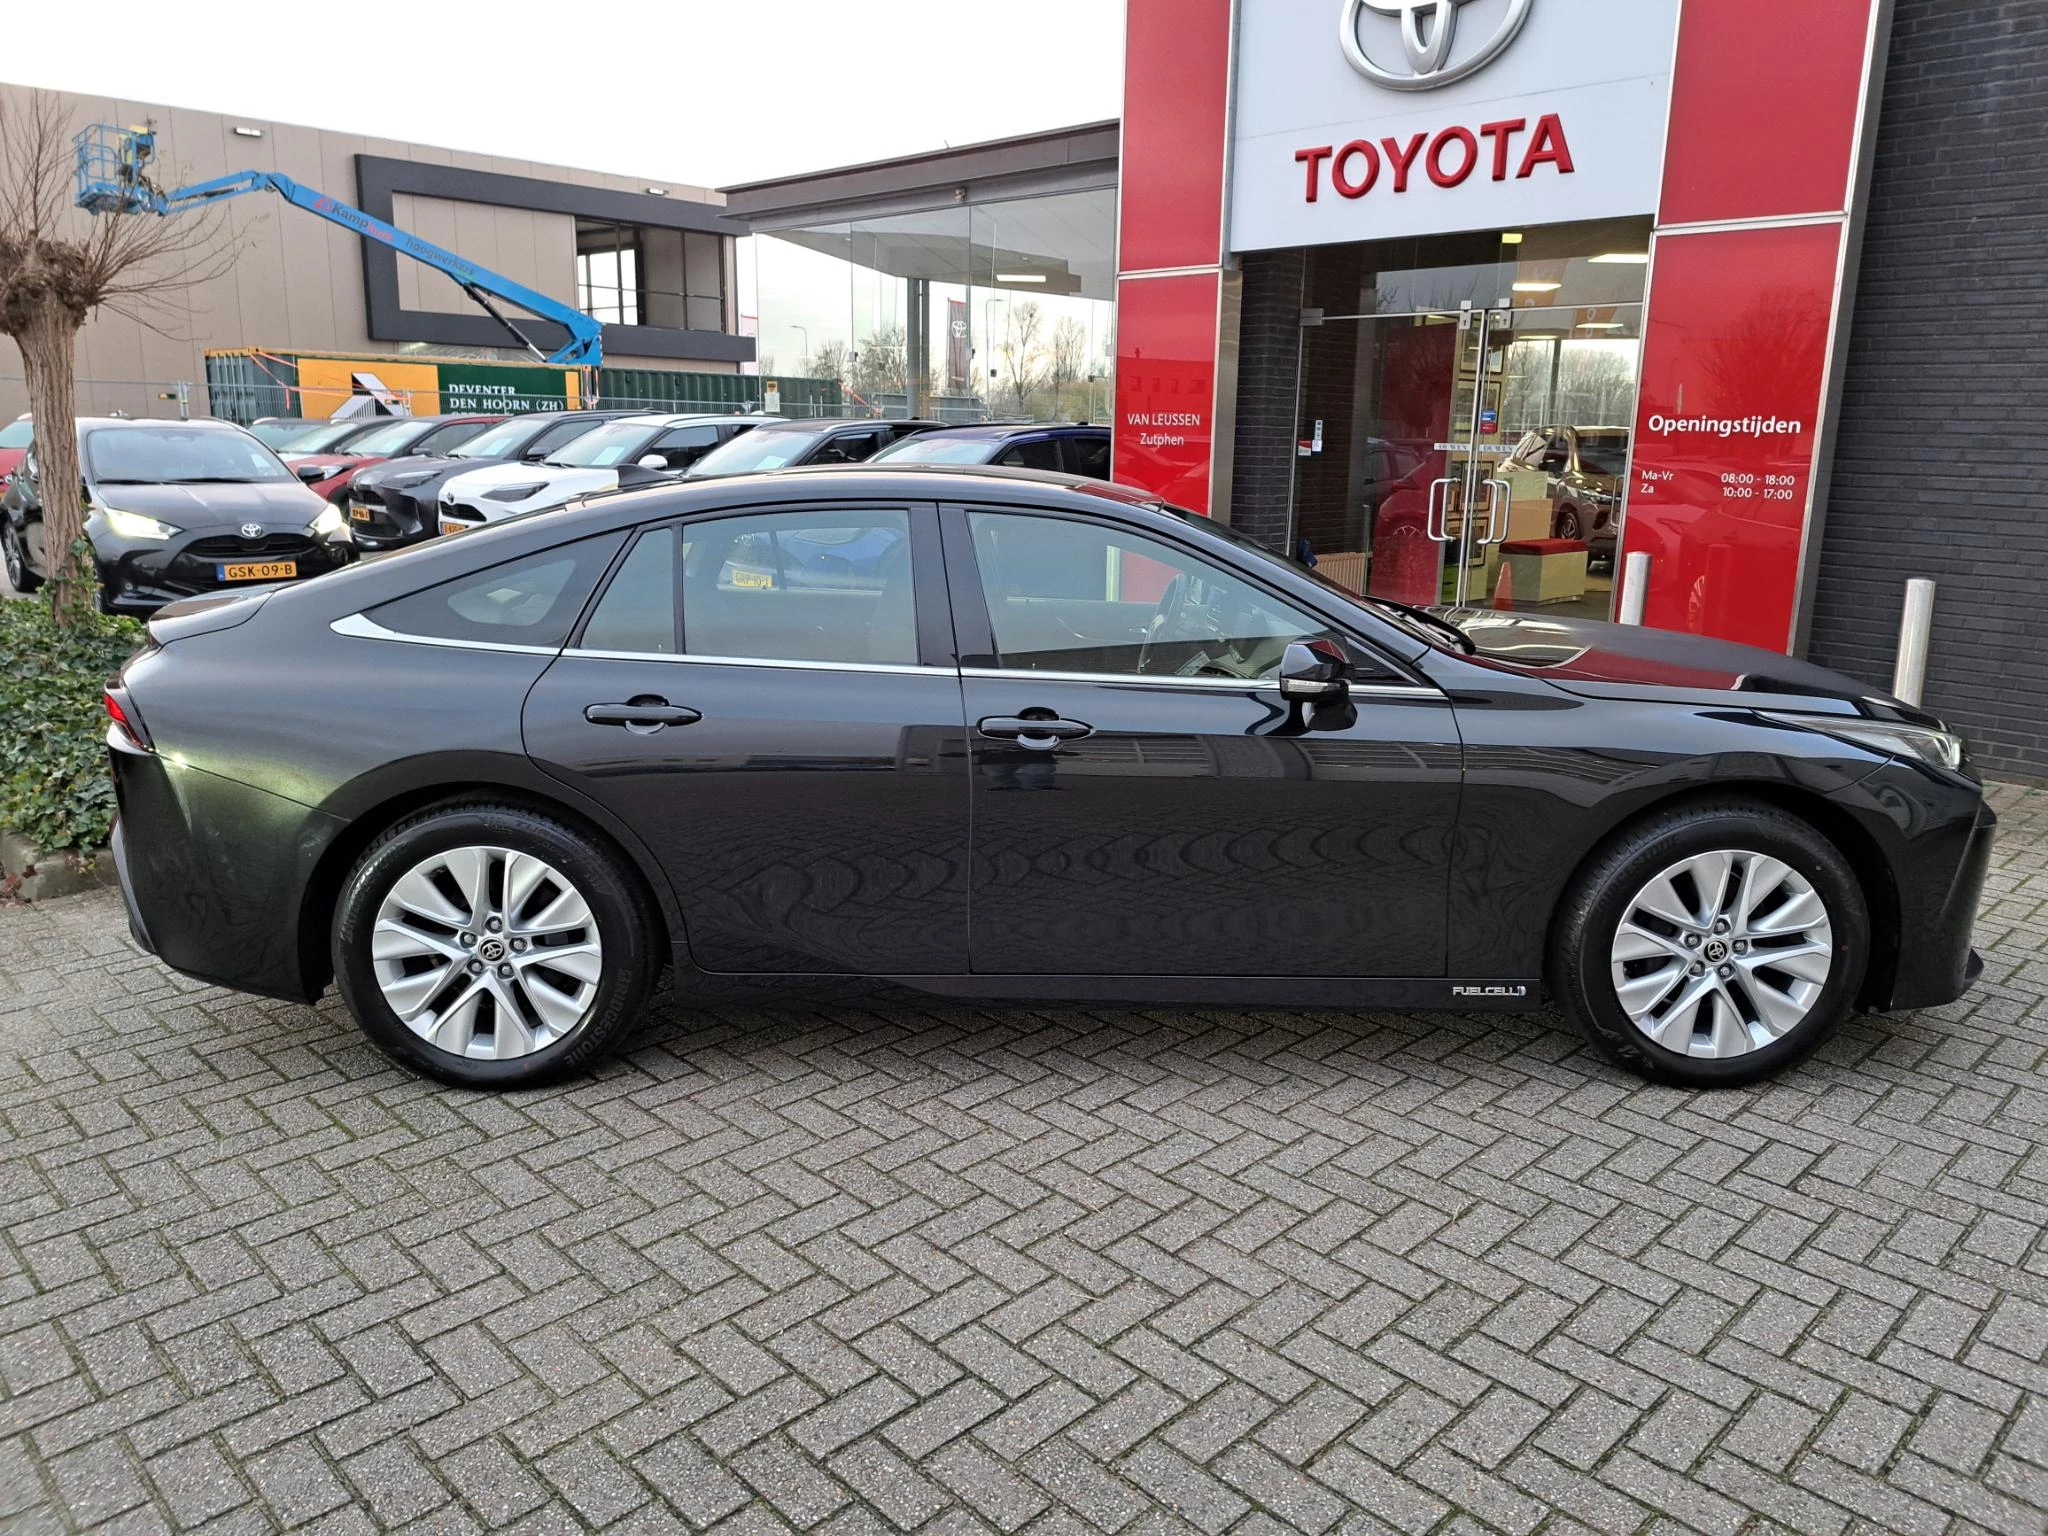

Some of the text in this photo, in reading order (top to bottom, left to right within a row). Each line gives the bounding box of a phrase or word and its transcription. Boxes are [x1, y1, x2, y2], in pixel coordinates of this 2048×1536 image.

[1294, 112, 1576, 203] TOYOTA
[448, 383, 516, 396] DEVENTER
[449, 397, 565, 412] DEN HOORN (ZH)
[1127, 413, 1201, 426] VAN LEUSSEN
[1648, 414, 1802, 438] Openingstijden
[1140, 432, 1185, 448] Zutphen
[1641, 470, 1674, 481] Ma-Vr
[1721, 473, 1754, 485] 08:00
[1765, 474, 1795, 486] 18:00
[1640, 483, 1655, 494] Za
[1723, 486, 1752, 498] 10:00
[1764, 488, 1793, 500] 17:00
[228, 564, 293, 578] GSK-09-B
[563, 967, 633, 1066] BRIDGESTONE
